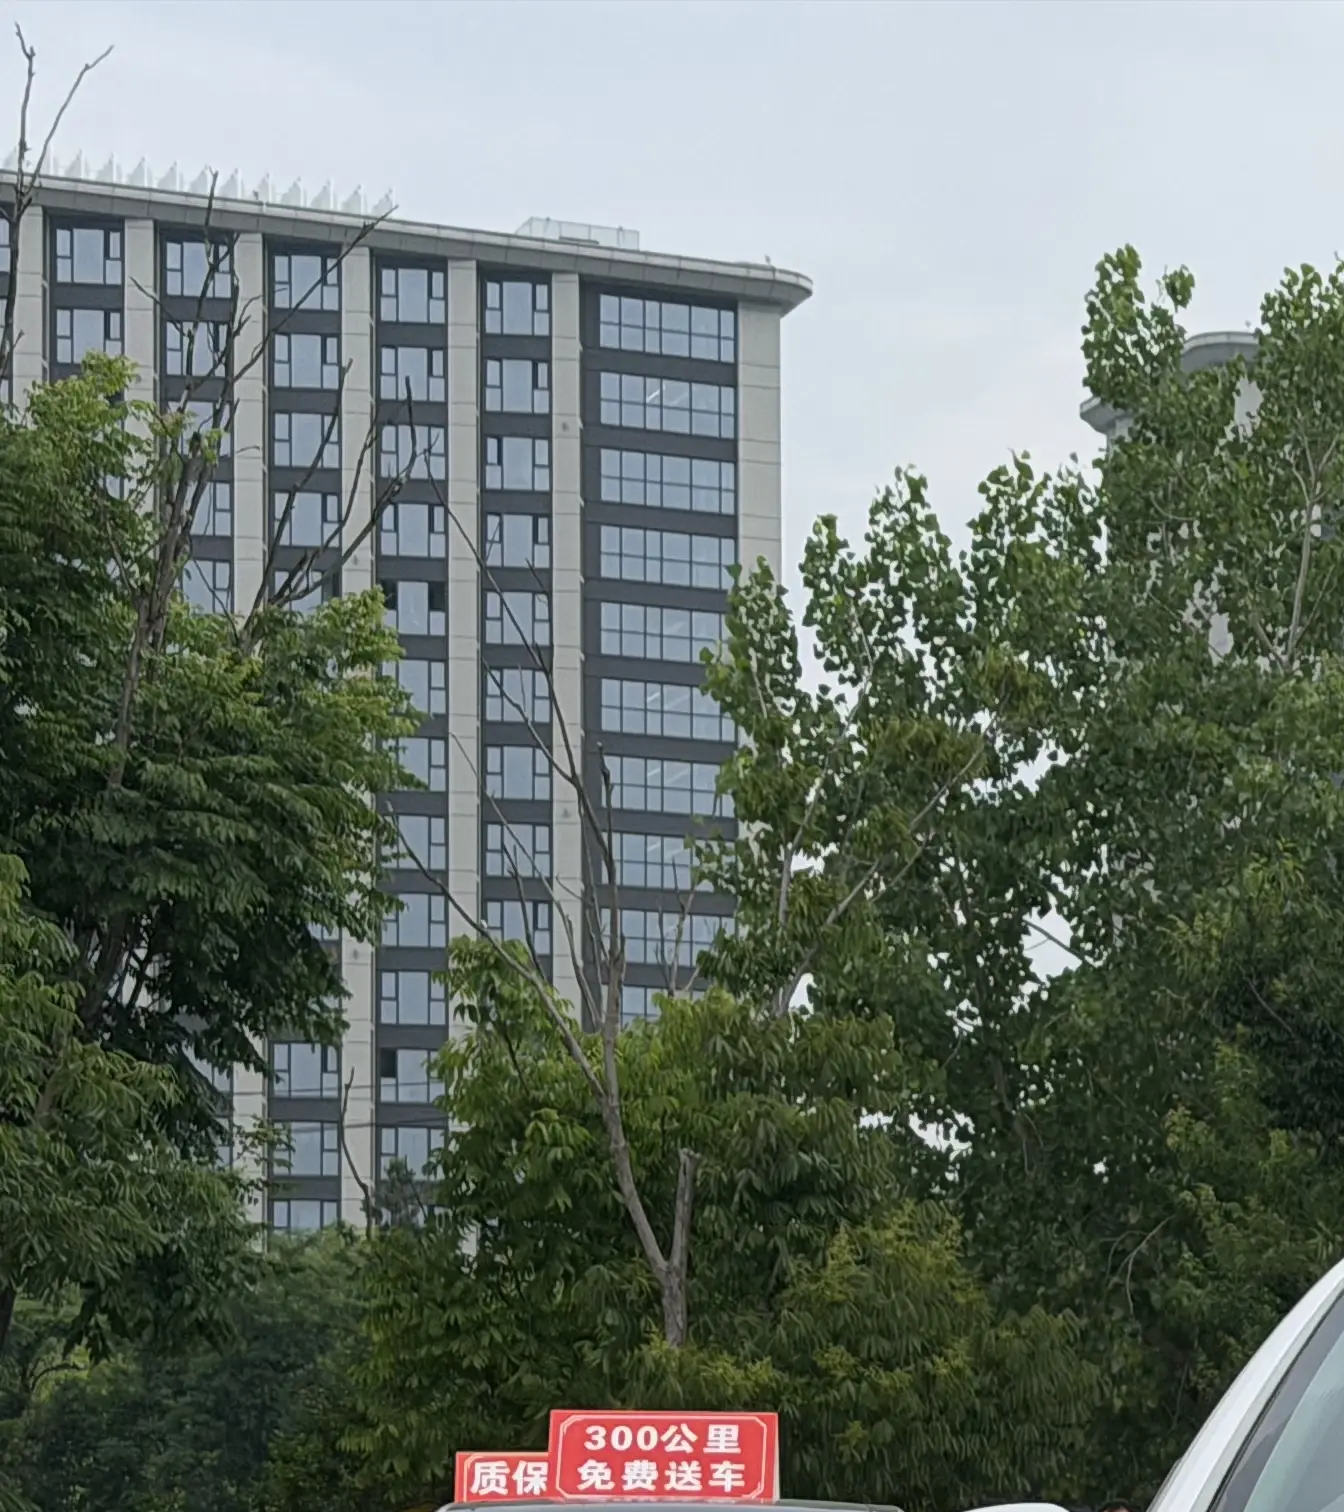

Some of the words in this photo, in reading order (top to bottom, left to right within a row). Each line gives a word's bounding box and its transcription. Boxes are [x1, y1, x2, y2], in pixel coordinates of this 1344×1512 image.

[584, 1423, 742, 1454] 300公里
[470, 1460, 547, 1496] 质保
[576, 1460, 745, 1493] 免费送车
